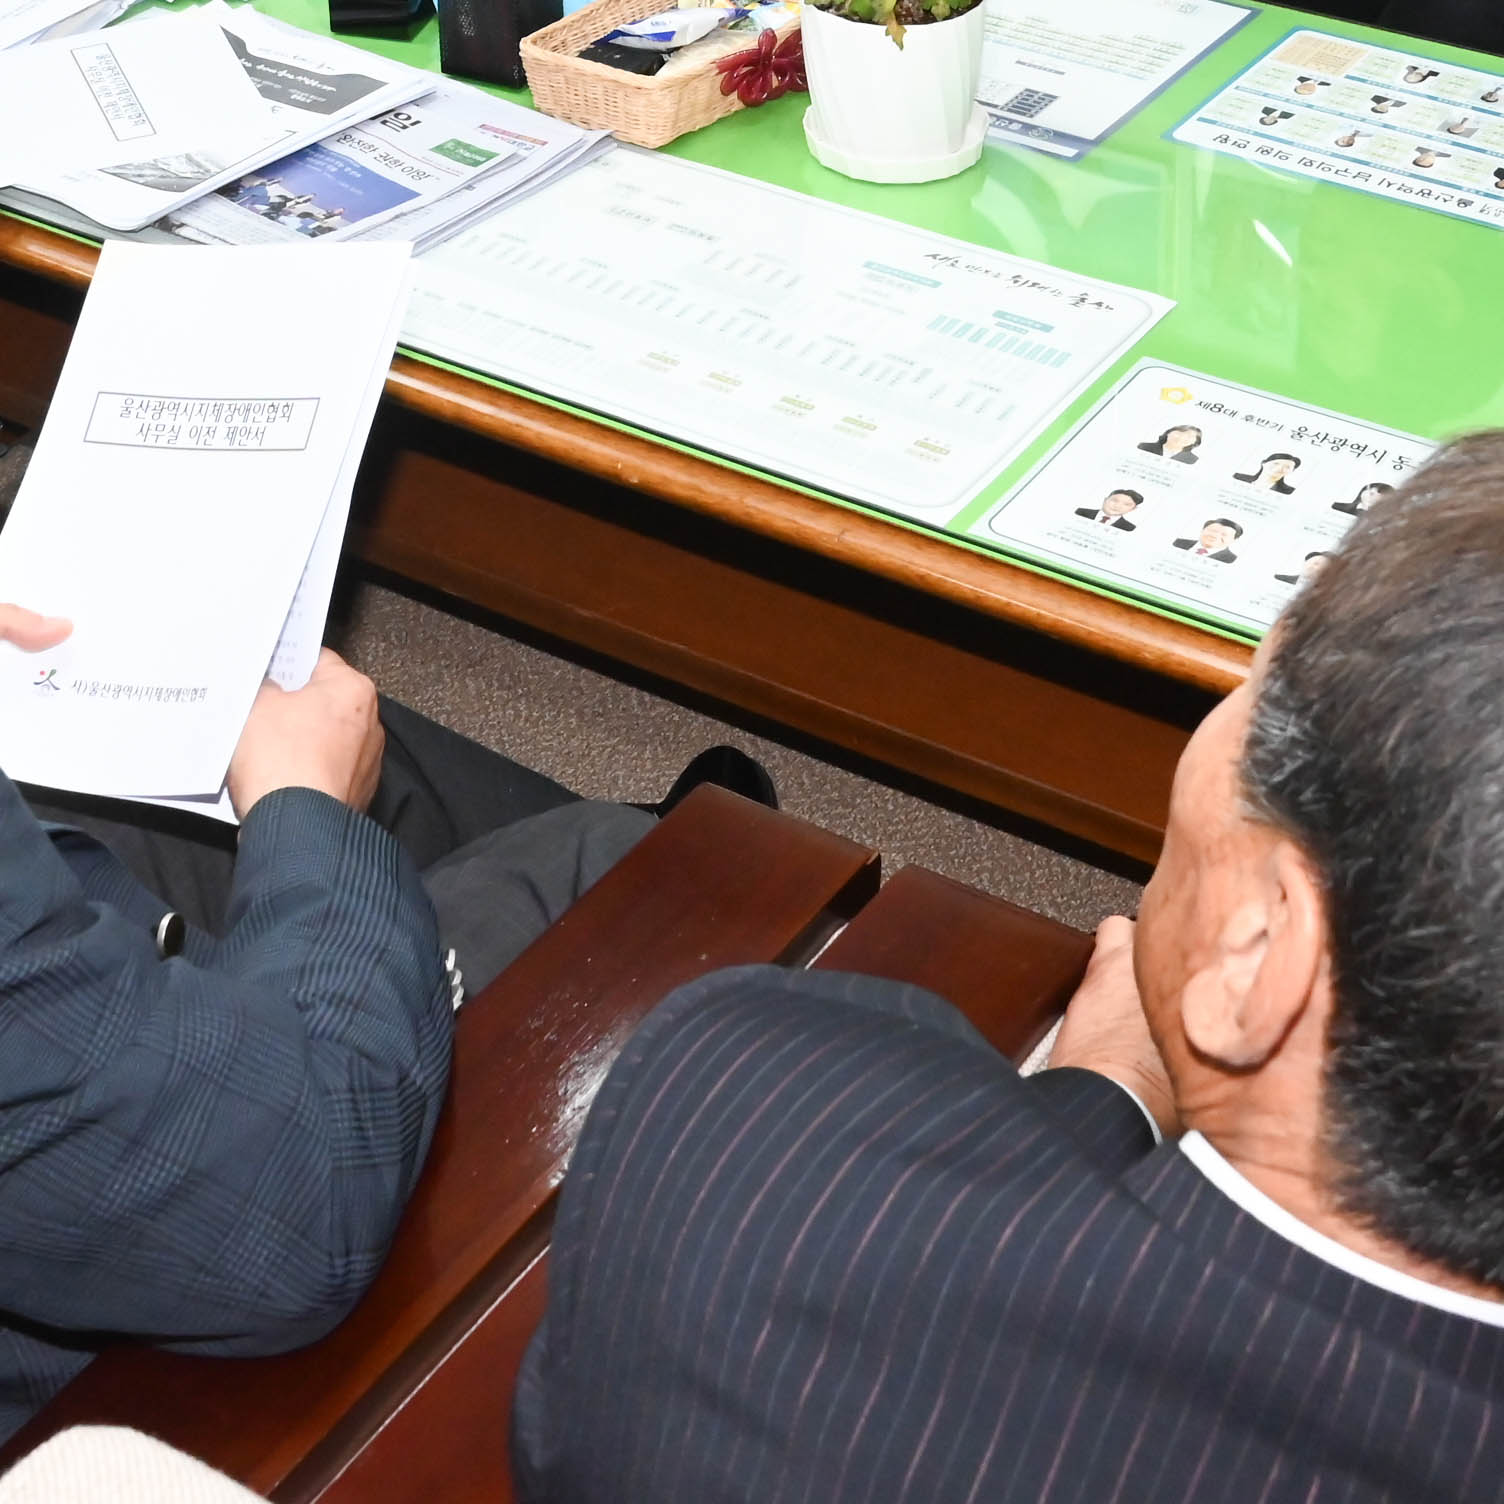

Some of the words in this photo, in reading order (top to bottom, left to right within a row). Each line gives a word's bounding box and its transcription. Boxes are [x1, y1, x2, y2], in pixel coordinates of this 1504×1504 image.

[119, 397, 295, 424] 울산광역시지체장애인협회
[135, 422, 182, 446] 사무실
[188, 424, 217, 447] 이전
[223, 425, 267, 447] 제안서
[1194, 399, 1239, 419] 제8대
[1243, 414, 1284, 433] 후반기
[1290, 425, 1388, 465] 울산광역시
